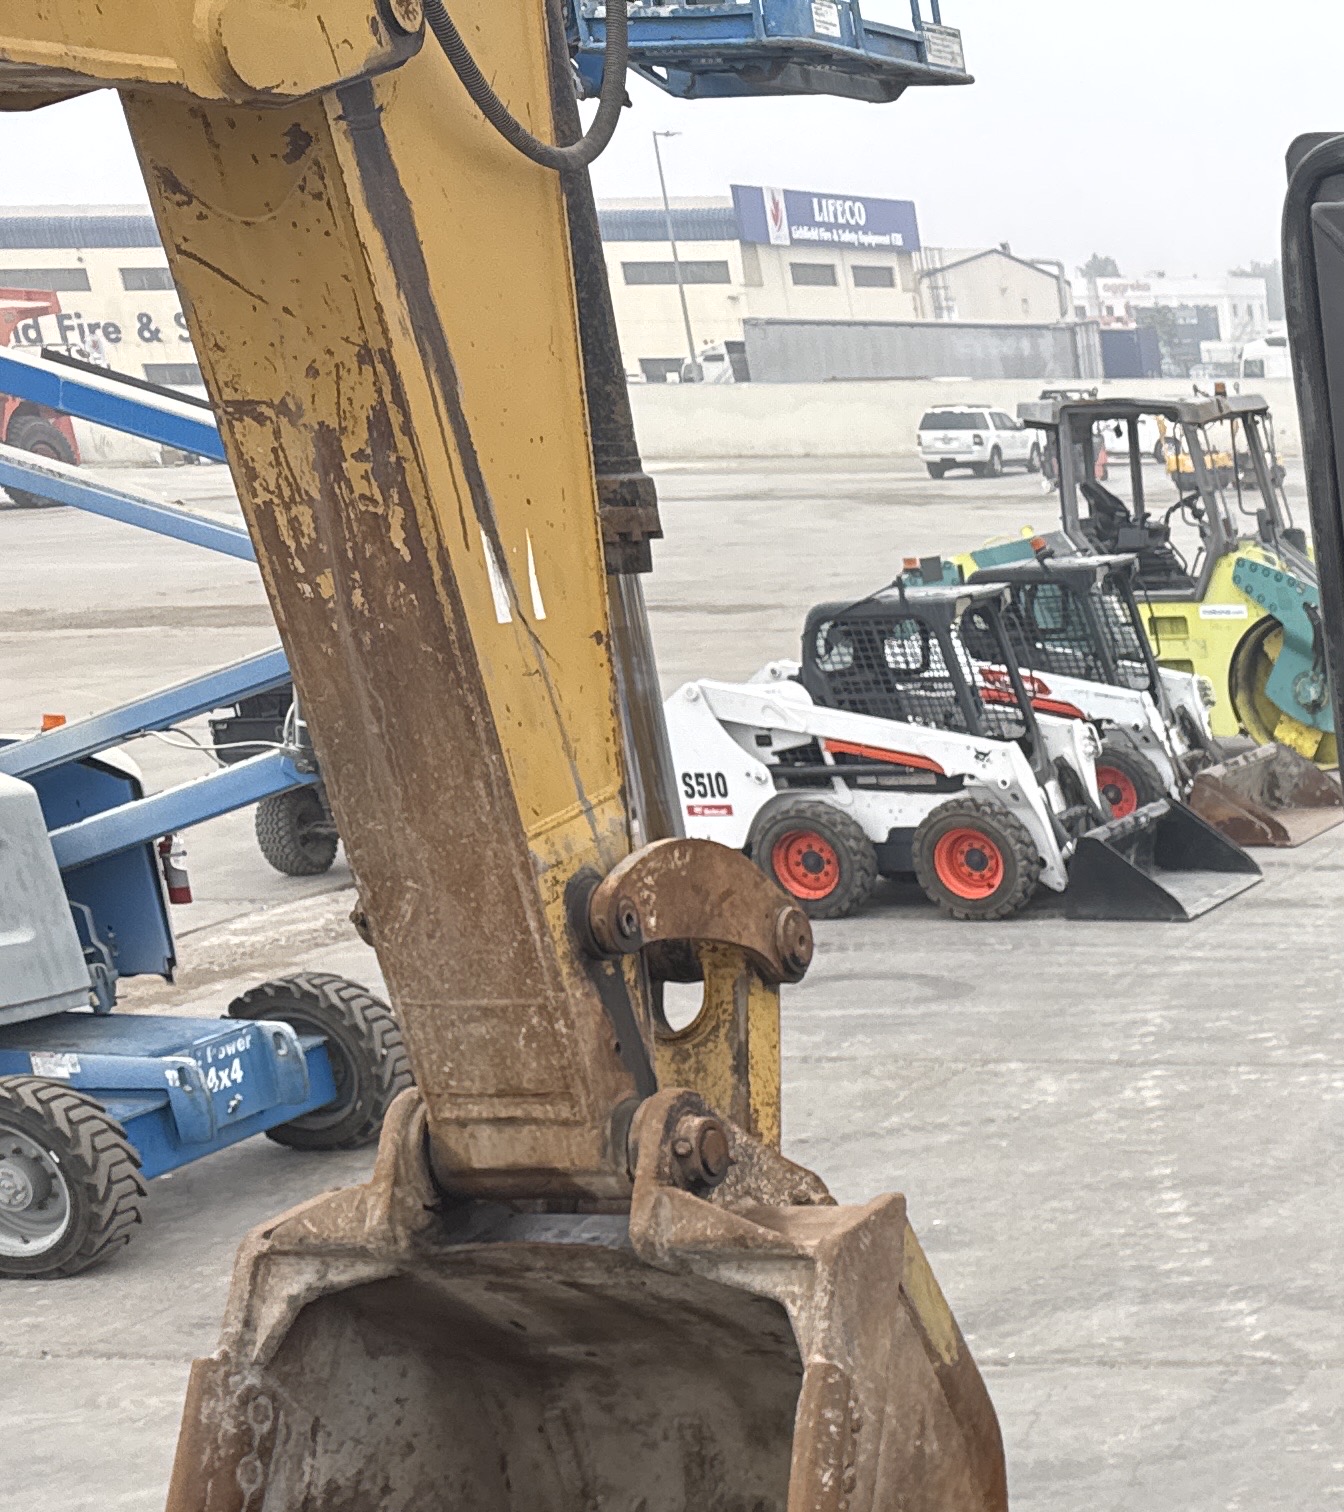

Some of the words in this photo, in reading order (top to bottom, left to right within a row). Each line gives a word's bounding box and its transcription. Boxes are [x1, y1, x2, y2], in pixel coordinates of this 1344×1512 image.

[812, 197, 866, 226] LIFECO
[57, 312, 122, 343] Fire
[137, 312, 163, 343] &
[681, 771, 729, 799] S510
